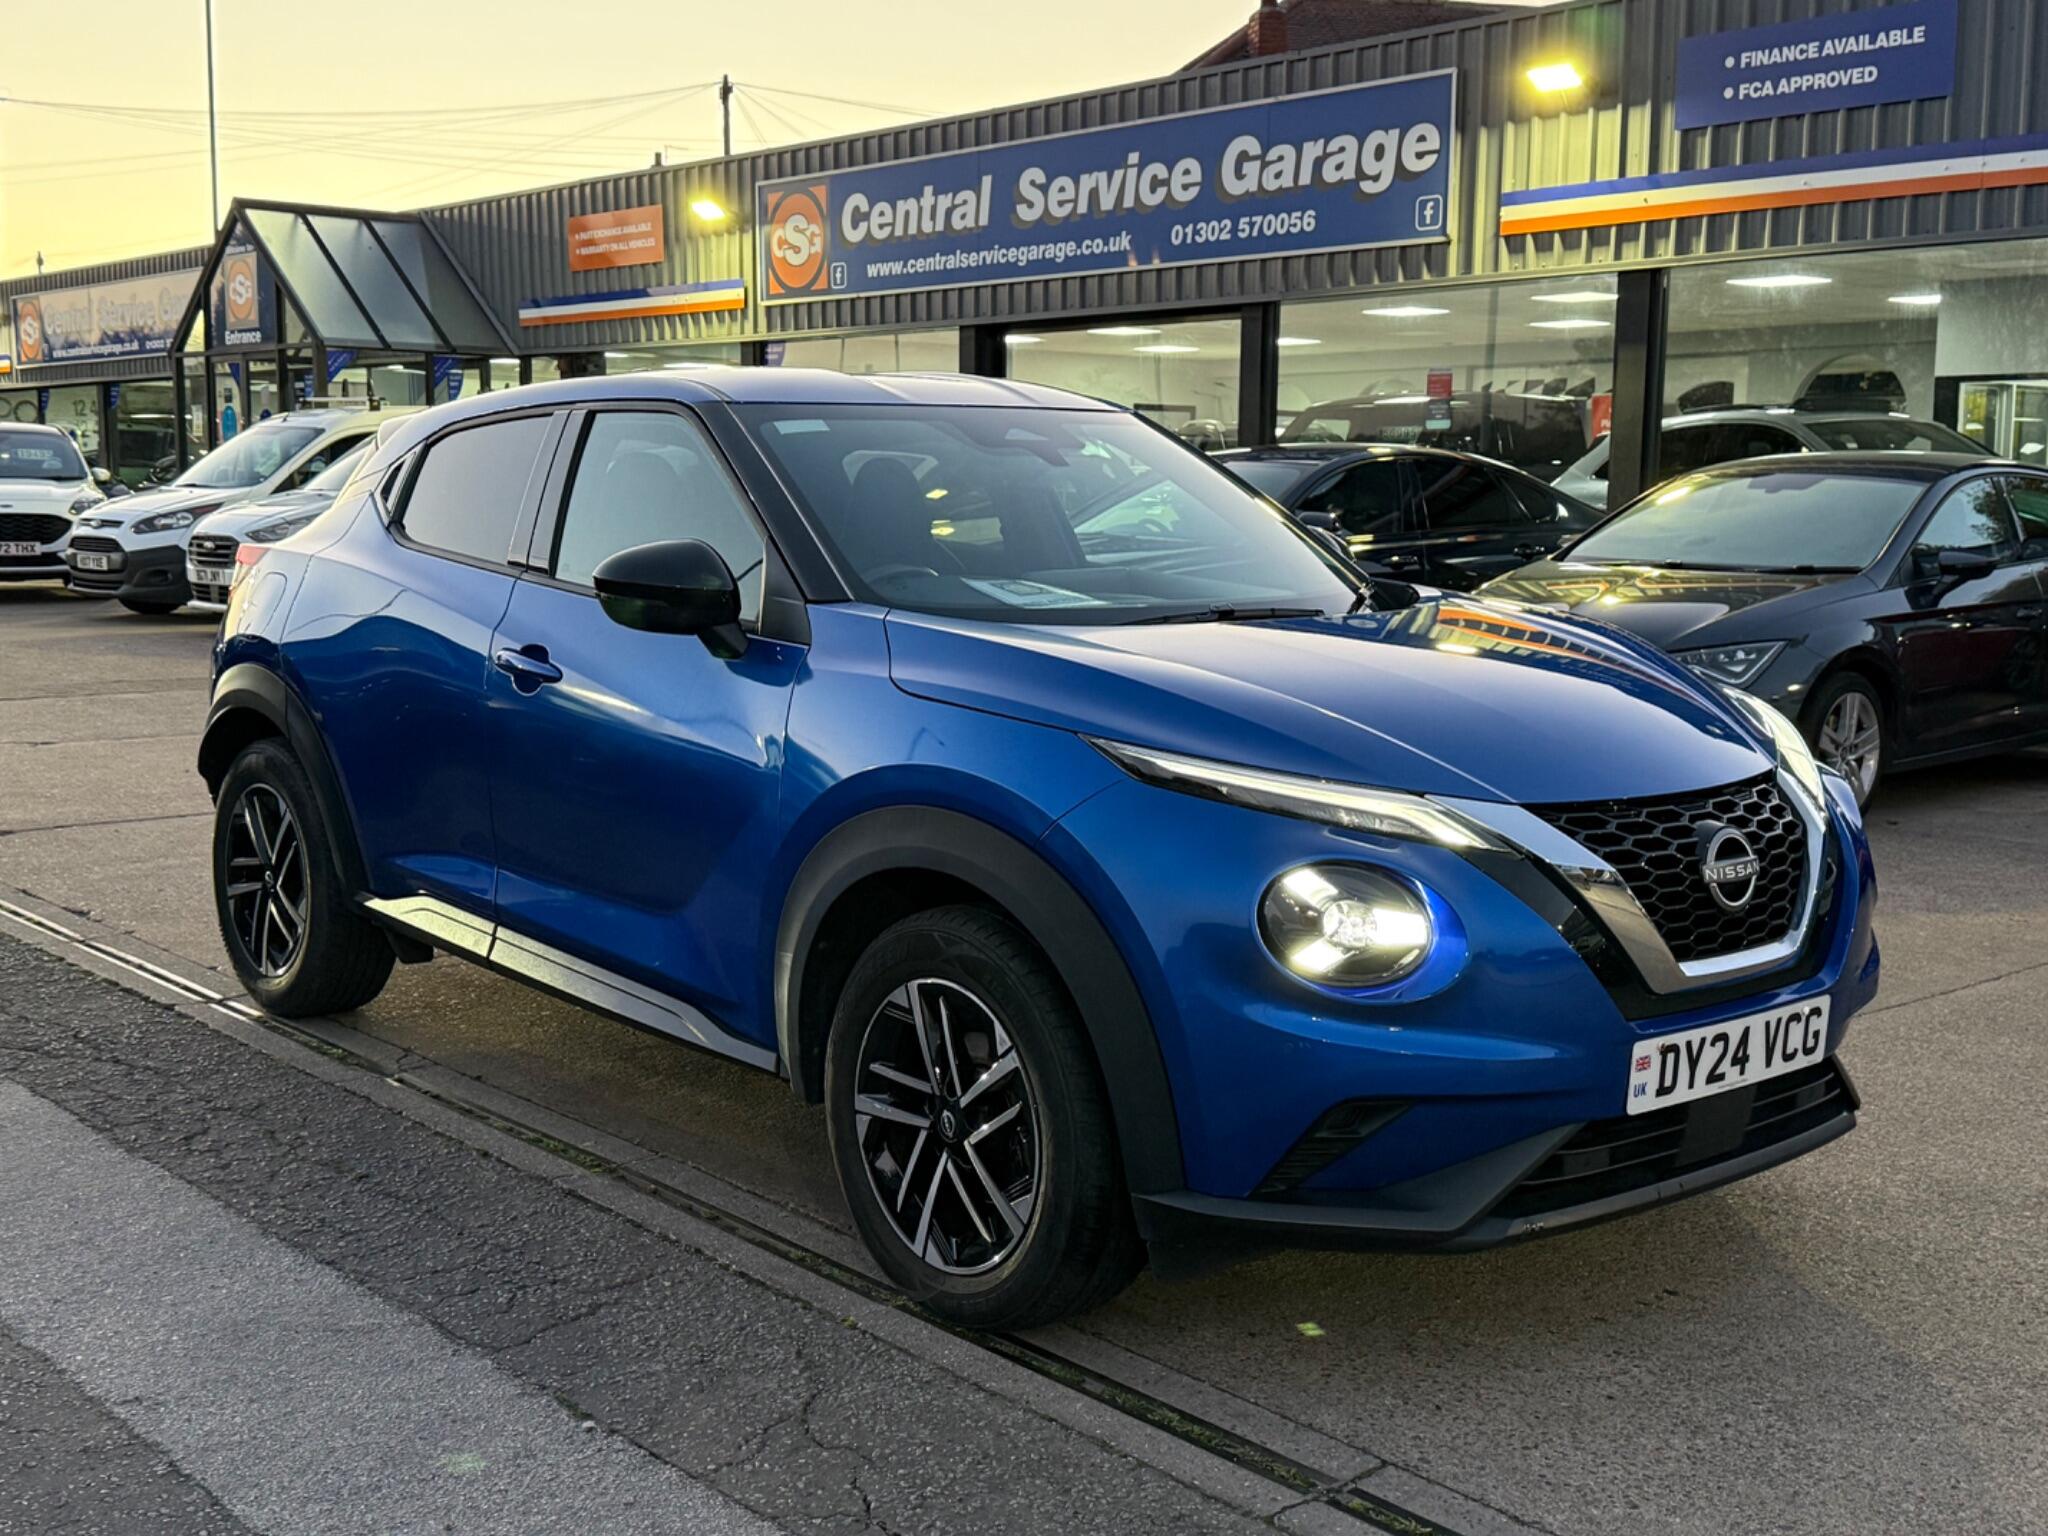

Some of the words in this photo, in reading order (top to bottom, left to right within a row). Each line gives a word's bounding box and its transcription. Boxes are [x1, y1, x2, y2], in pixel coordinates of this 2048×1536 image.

[1740, 41, 1819, 68] FINANCE
[1821, 25, 1926, 56] AVAILABLE
[1738, 80, 1774, 100] FCA
[1776, 65, 1878, 95] APPROVED
[841, 175, 992, 243] Central
[1016, 152, 1201, 222] Service
[1221, 122, 1441, 195] Garage
[867, 231, 1131, 277] www.centralservicegarage.co.uk
[1171, 222, 1231, 246] 01302
[1237, 210, 1316, 239] 570056
[225, 330, 262, 345] Entrance
[15, 543, 36, 553] THX
[1705, 861, 1759, 880] NISSAN
[1655, 1026, 1750, 1098] DY24
[1765, 1006, 1822, 1068] VCG
[1633, 1082, 1648, 1098] UK
